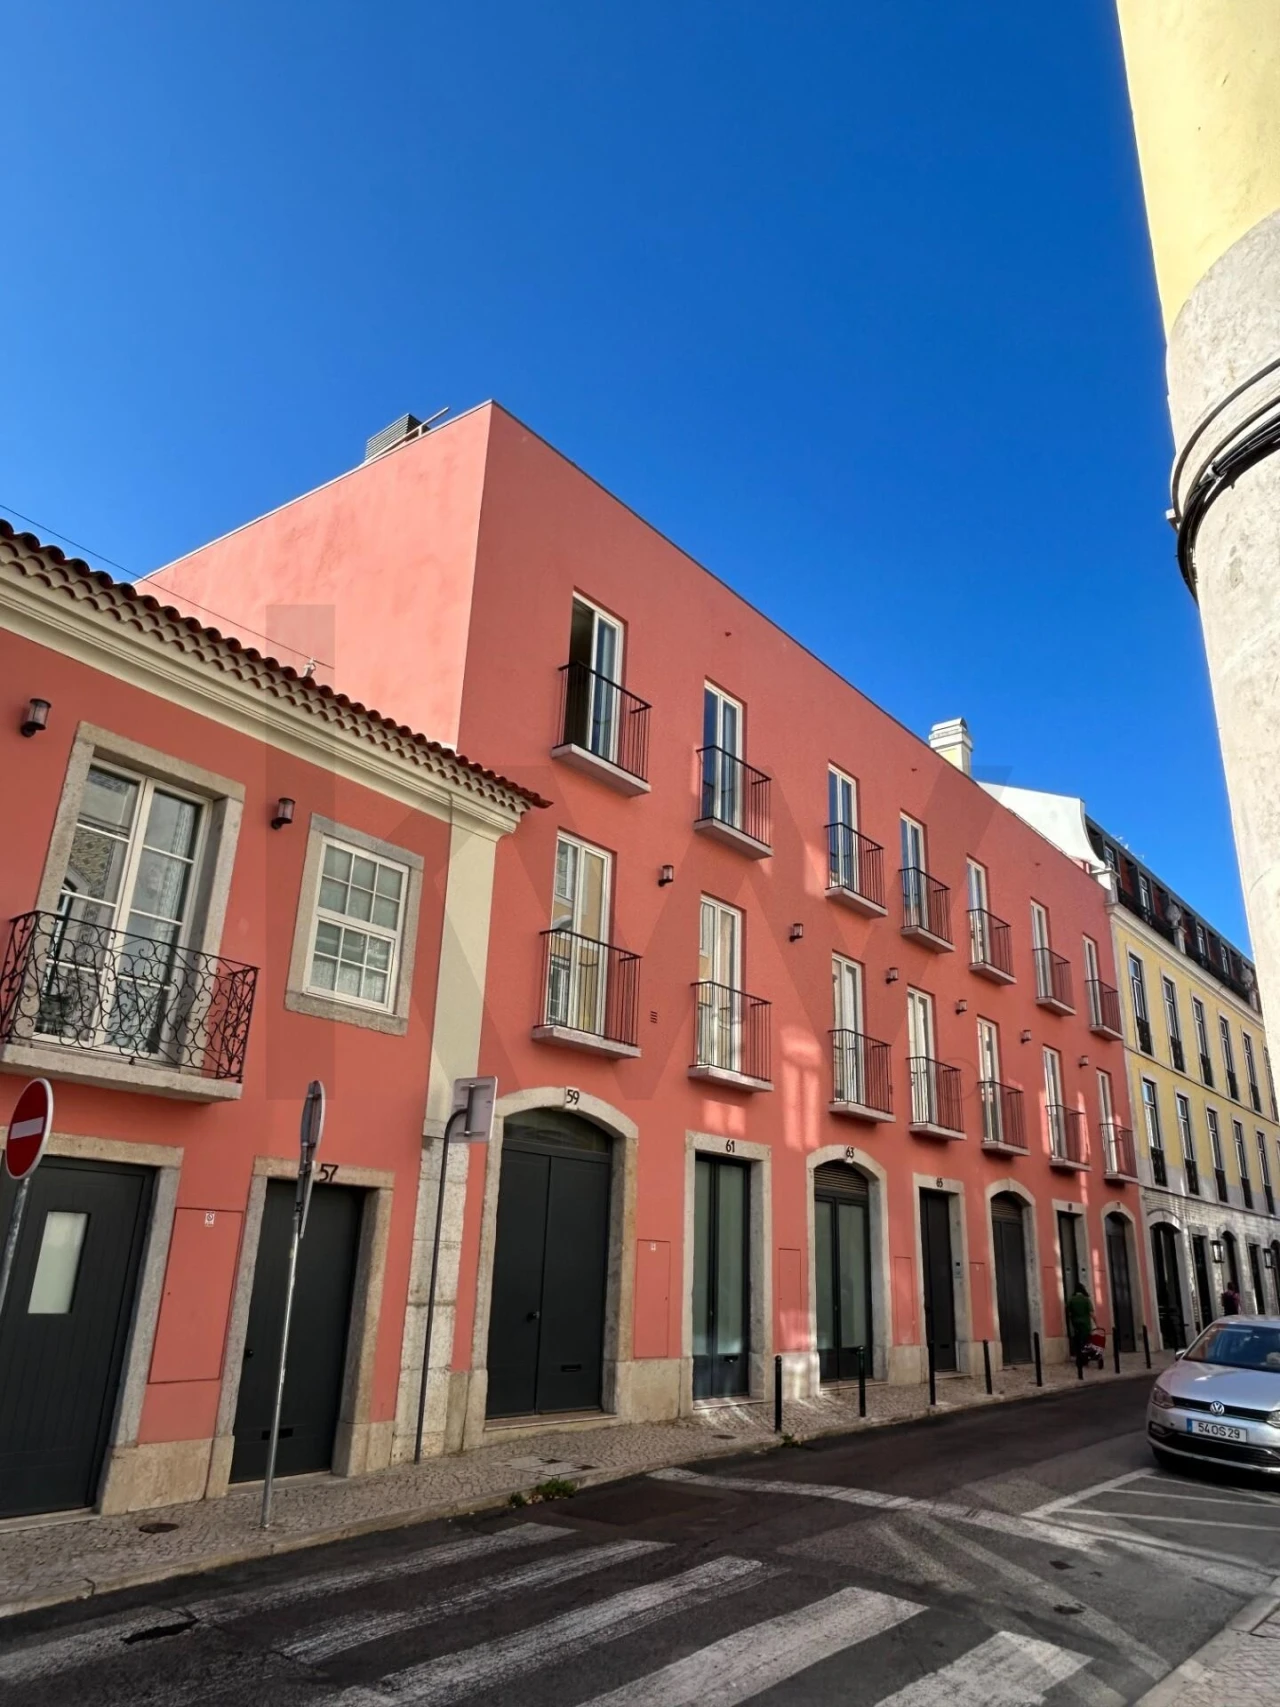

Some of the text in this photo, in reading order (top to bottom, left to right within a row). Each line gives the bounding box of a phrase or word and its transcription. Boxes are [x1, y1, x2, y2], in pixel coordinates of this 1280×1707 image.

[566, 1089, 580, 1105] 59
[725, 1139, 735, 1153] 61
[845, 1146, 855, 1158] 63
[319, 1163, 339, 1183] 57
